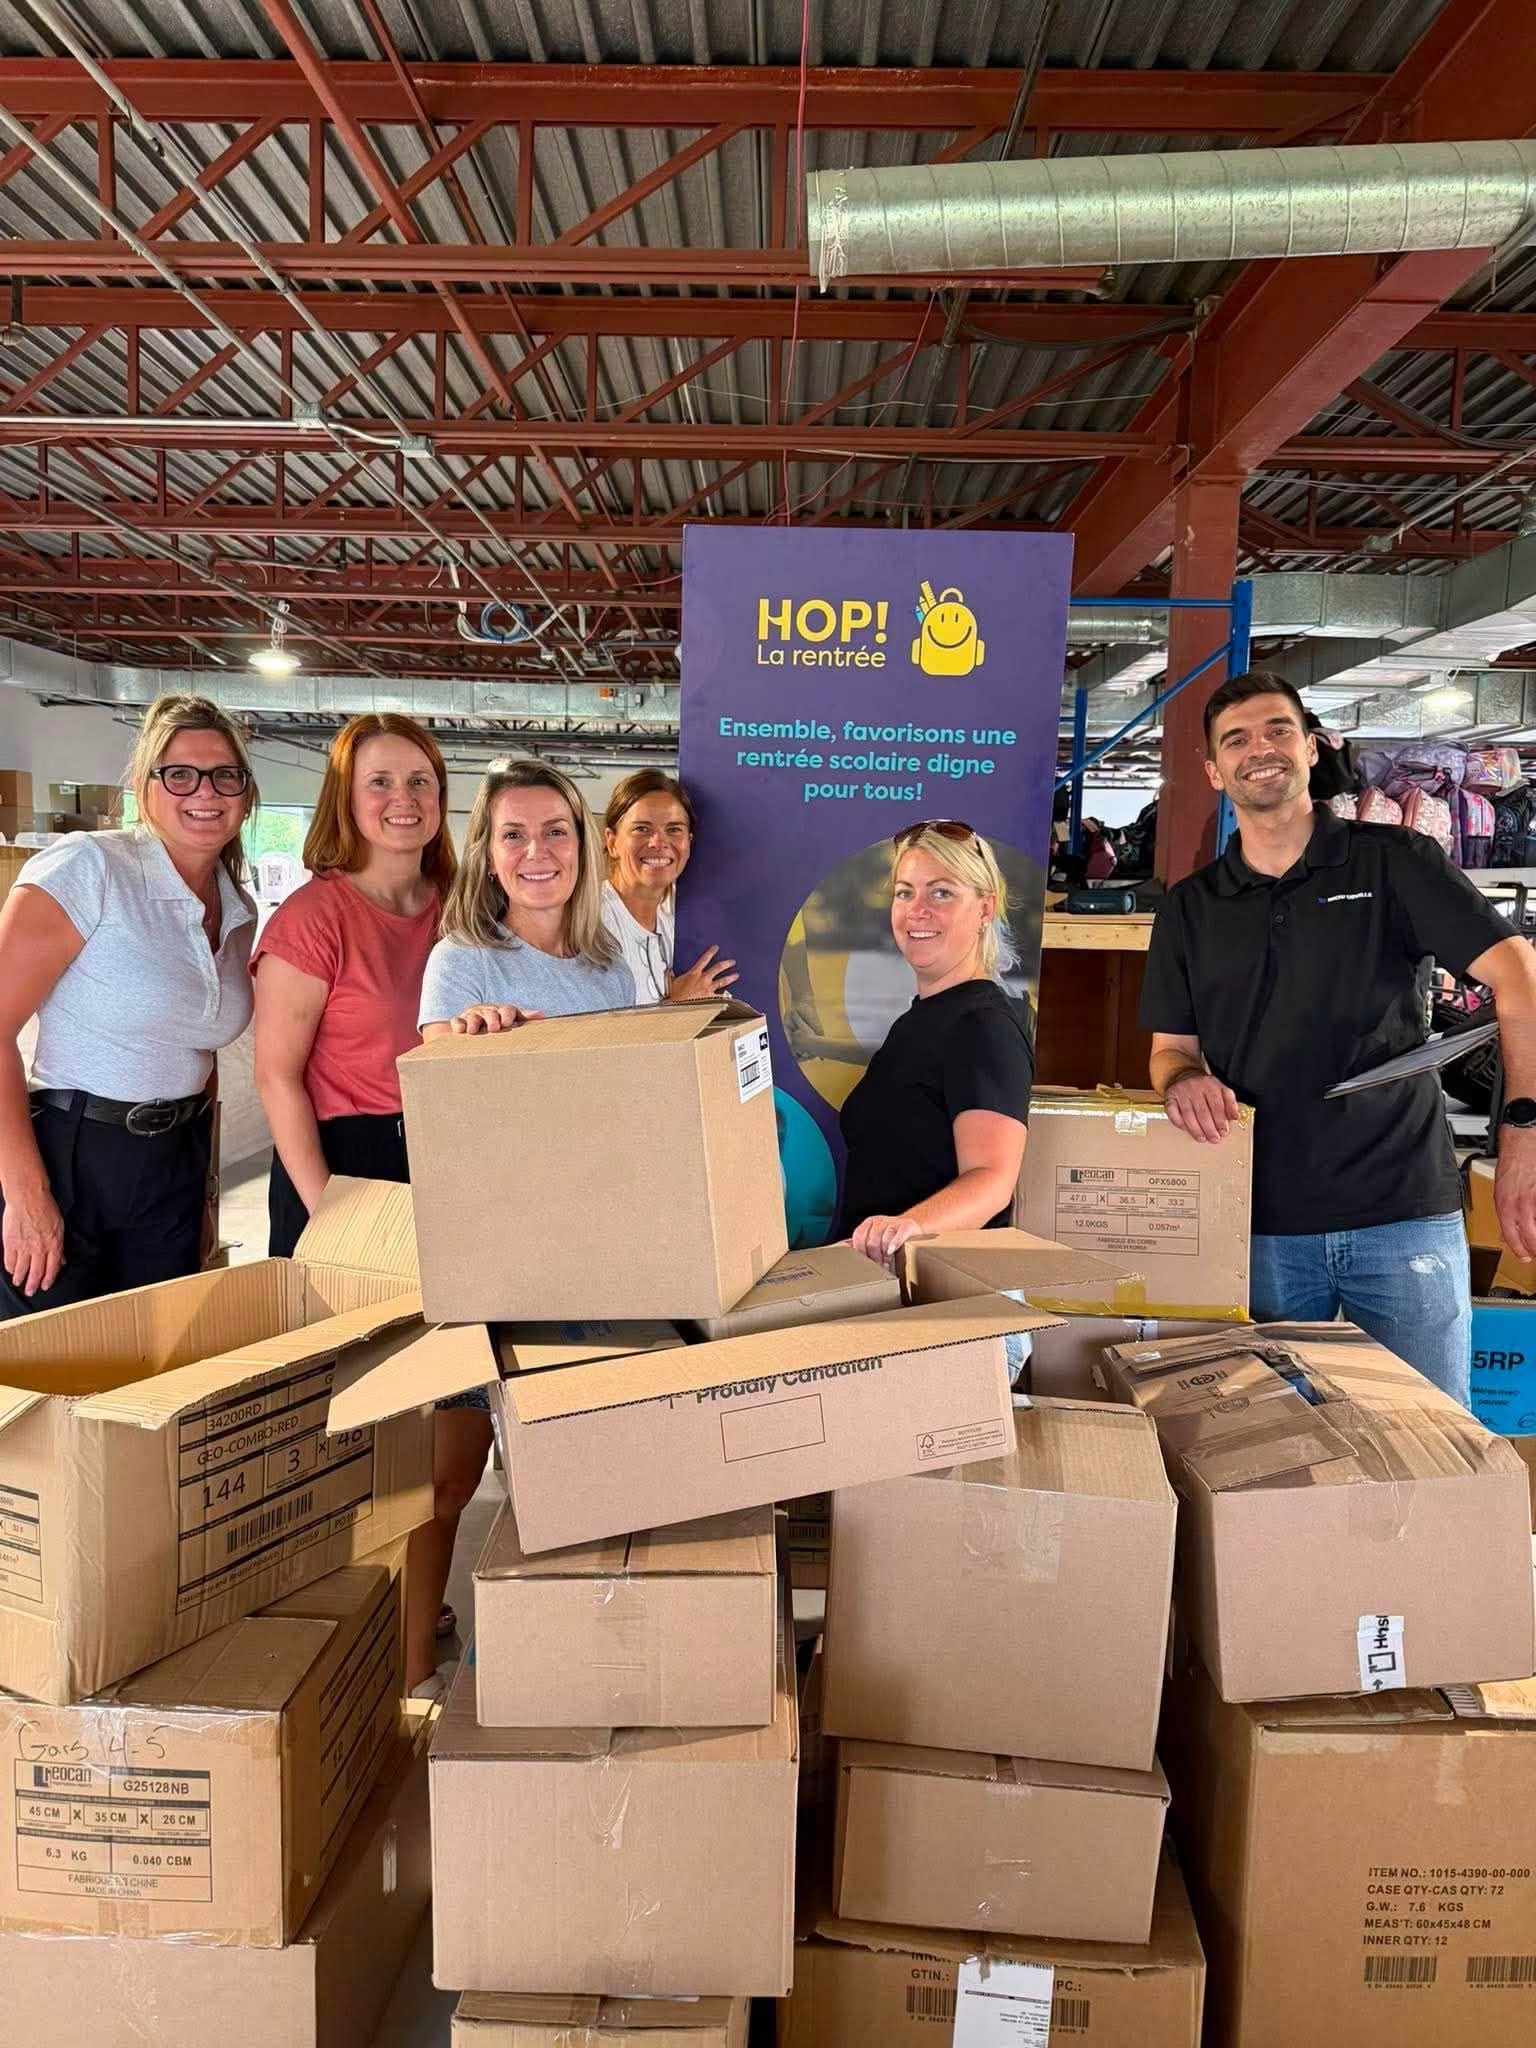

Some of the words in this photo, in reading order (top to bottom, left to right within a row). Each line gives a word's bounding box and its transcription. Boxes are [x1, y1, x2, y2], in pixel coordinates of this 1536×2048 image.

[758, 598, 889, 644] HOP!
[757, 644, 785, 665] La
[792, 645, 887, 667] rentrée
[719, 717, 837, 743] Ensemble,
[843, 721, 966, 744] favorisons
[972, 728, 1017, 745] une
[736, 748, 824, 768] rentrée
[829, 751, 921, 772] scolaire
[927, 754, 995, 779] digne
[804, 782, 858, 802] pour
[863, 782, 923, 801] tous!
[207, 1402, 262, 1432] 34200RD
[197, 1415, 299, 1465] GEO-COMBO-RED
[202, 1471, 246, 1510] 144
[287, 1450, 300, 1474] 3
[123, 1780, 190, 1795] G25128NB
[29, 1805, 41, 1816] 45
[44, 1806, 60, 1818] CM
[95, 1811, 107, 1822] 35
[110, 1812, 127, 1823] CM
[162, 1814, 176, 1825] 26
[178, 1814, 196, 1825] CM
[46, 1847, 62, 1859] 6.3
[71, 1850, 88, 1862] KG
[132, 1854, 162, 1866] 0.040
[166, 1855, 192, 1867] CBM
[1368, 1867, 1399, 1878] ITEM
[1429, 1868, 1531, 1879] 1015-4390-00-000
[129, 1878, 159, 1889] CHINE
[1367, 1884, 1401, 1895] CASE
[1403, 1885, 1457, 1896] QTY-CAS
[1460, 1885, 1488, 1896] QTY:
[1490, 1885, 1505, 1896] 72
[1366, 1901, 1398, 1912] G.W.:
[1408, 1902, 1426, 1912] 7.6
[1438, 1902, 1464, 1912] KGS
[1364, 1918, 1413, 1929] MEAS'T:
[1416, 1919, 1470, 1929] 60x45x48
[1473, 1919, 1491, 1929] CM
[1362, 1935, 1401, 1945] INNER
[1403, 1936, 1431, 1946] QTY:
[1435, 1936, 1448, 1945] 12
